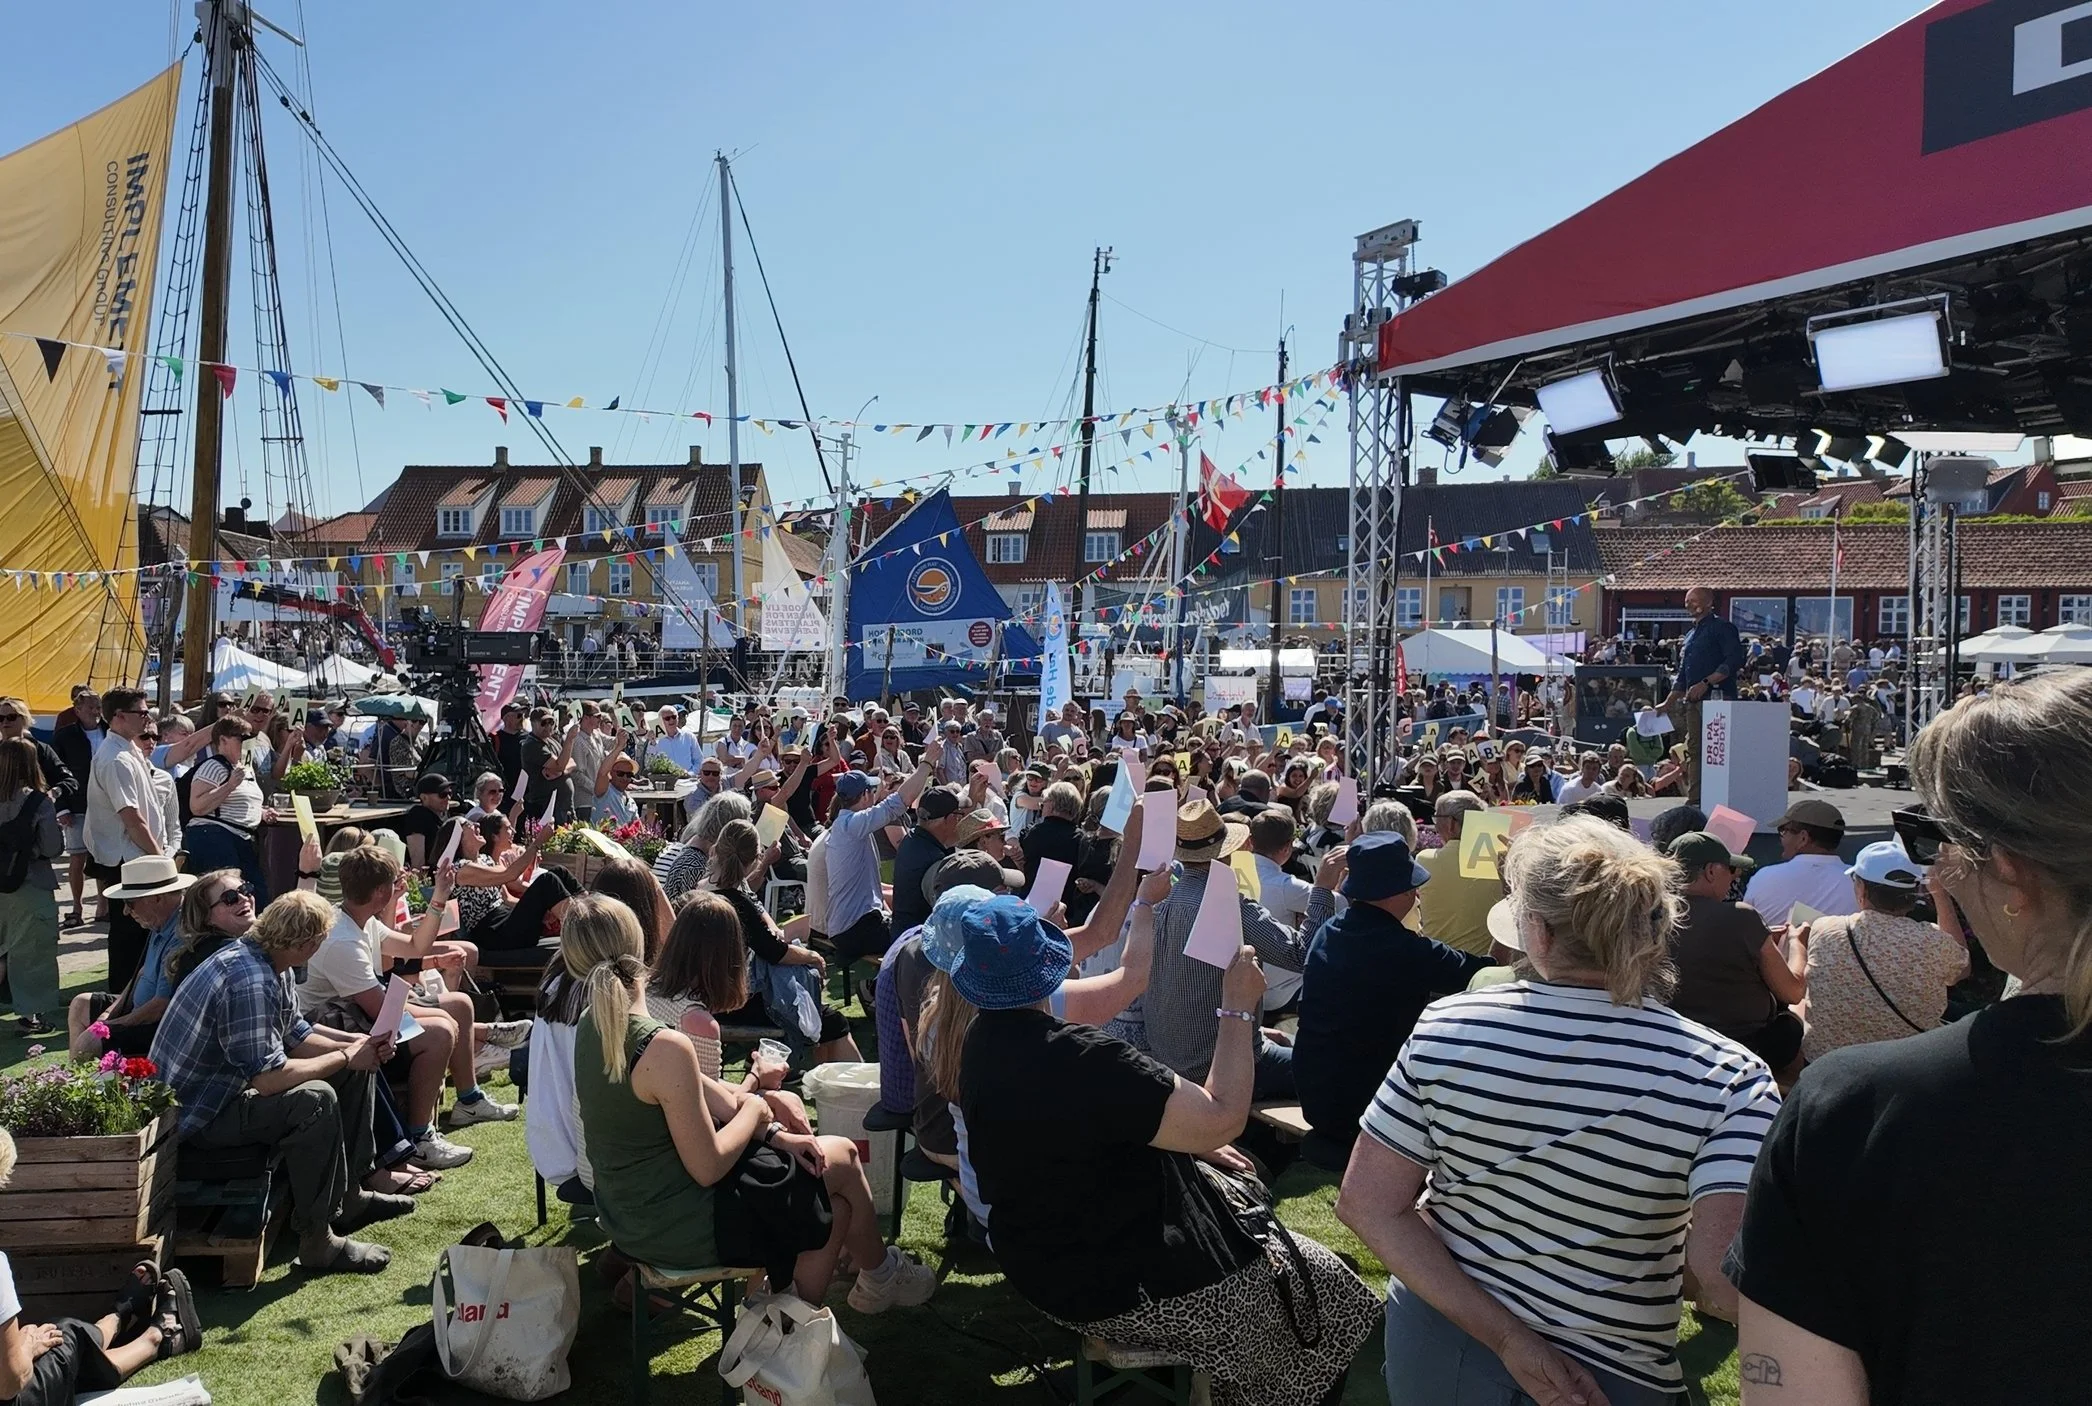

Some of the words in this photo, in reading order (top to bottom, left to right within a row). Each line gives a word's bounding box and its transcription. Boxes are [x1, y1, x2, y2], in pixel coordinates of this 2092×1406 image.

[101, 160, 119, 265] CONSULTING
[243, 694, 254, 709] A
[277, 695, 286, 709] A
[615, 690, 623, 704] A
[291, 708, 304, 726] A
[621, 715, 635, 728] A
[781, 716, 789, 729] A
[655, 724, 666, 738] A
[1207, 725, 1214, 735] A
[1402, 723, 1410, 733] C
[801, 734, 810, 746] A
[1237, 734, 1243, 743] A
[1280, 732, 1289, 744] A
[1037, 743, 1047, 753] A
[1076, 743, 1085, 756] C
[1424, 741, 1434, 753] A
[1561, 740, 1569, 750] B
[244, 750, 252, 766] A
[1469, 749, 1477, 760] A
[1483, 747, 1494, 759] B
[1706, 744, 1713, 765] DR
[1178, 760, 1188, 771] A
[1084, 769, 1091, 780] A
[1474, 777, 1485, 789] A
[1466, 832, 1499, 869] A
[1235, 868, 1256, 898] A
